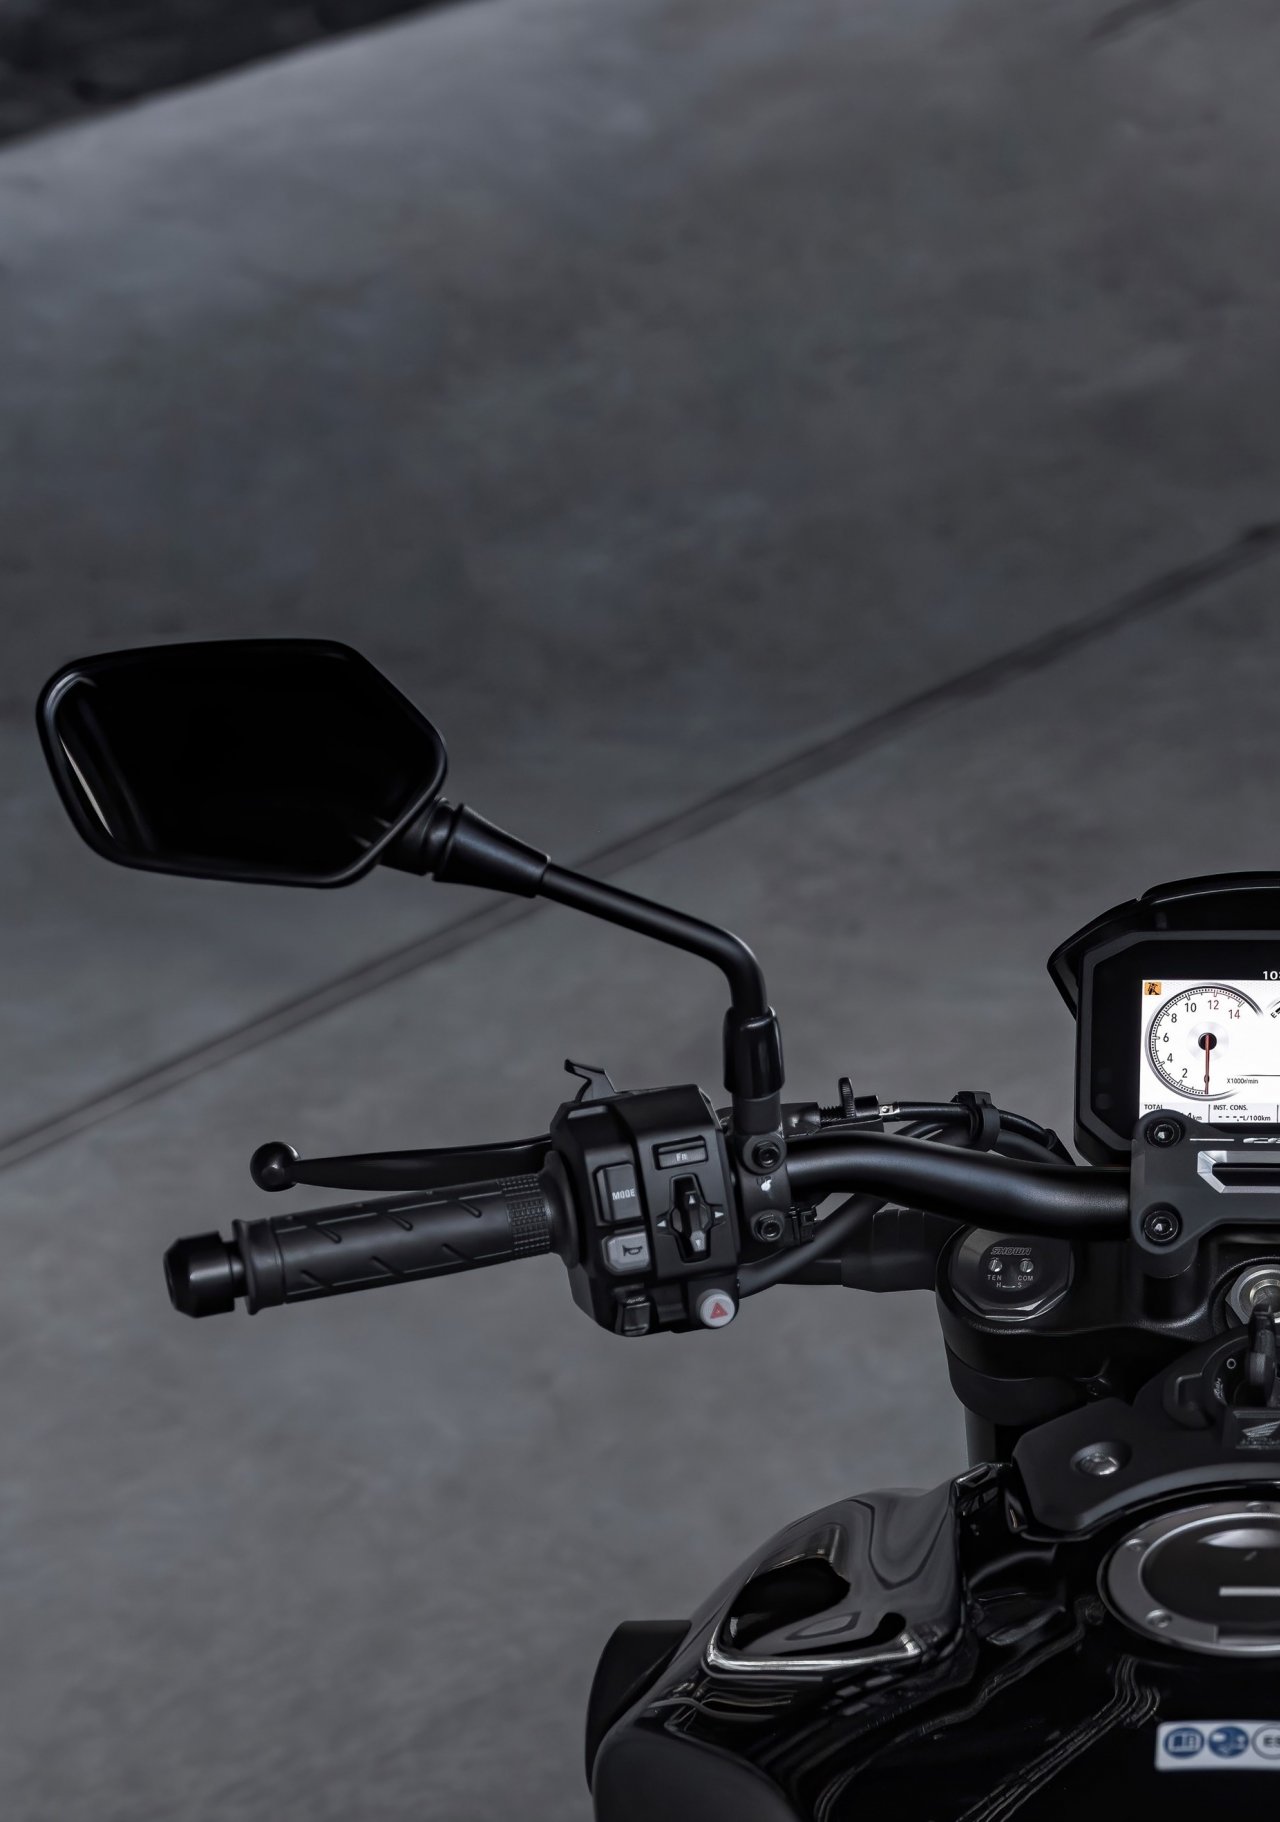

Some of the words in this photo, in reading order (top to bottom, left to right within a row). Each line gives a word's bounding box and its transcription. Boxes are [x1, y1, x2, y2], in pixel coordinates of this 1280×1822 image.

[1184, 1002, 1197, 1013] 10
[1207, 1000, 1220, 1010] 12
[1171, 1013, 1178, 1023] 8
[1228, 1009, 1241, 1020] 14
[1162, 1033, 1170, 1043] 6
[1166, 1052, 1174, 1063] 4
[1181, 1067, 1188, 1079] 2
[1143, 1103, 1164, 1111] TOTAL
[611, 1188, 636, 1201] MODE
